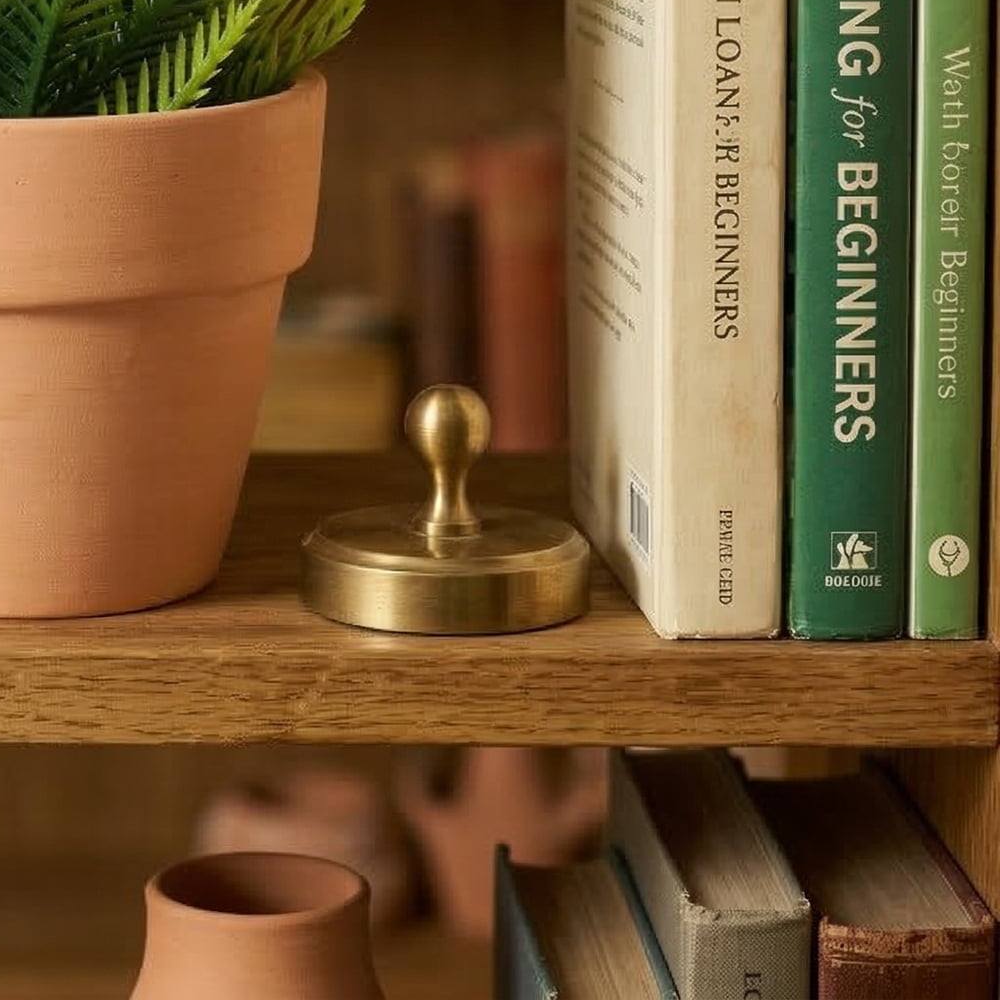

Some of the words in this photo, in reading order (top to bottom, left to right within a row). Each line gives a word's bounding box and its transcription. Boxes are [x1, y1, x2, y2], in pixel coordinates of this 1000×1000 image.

[829, 86, 878, 149] for
[714, 172, 740, 339] BEGINNERS
[833, 162, 879, 444] BEGINNERS
[932, 251, 967, 399] Beginners
